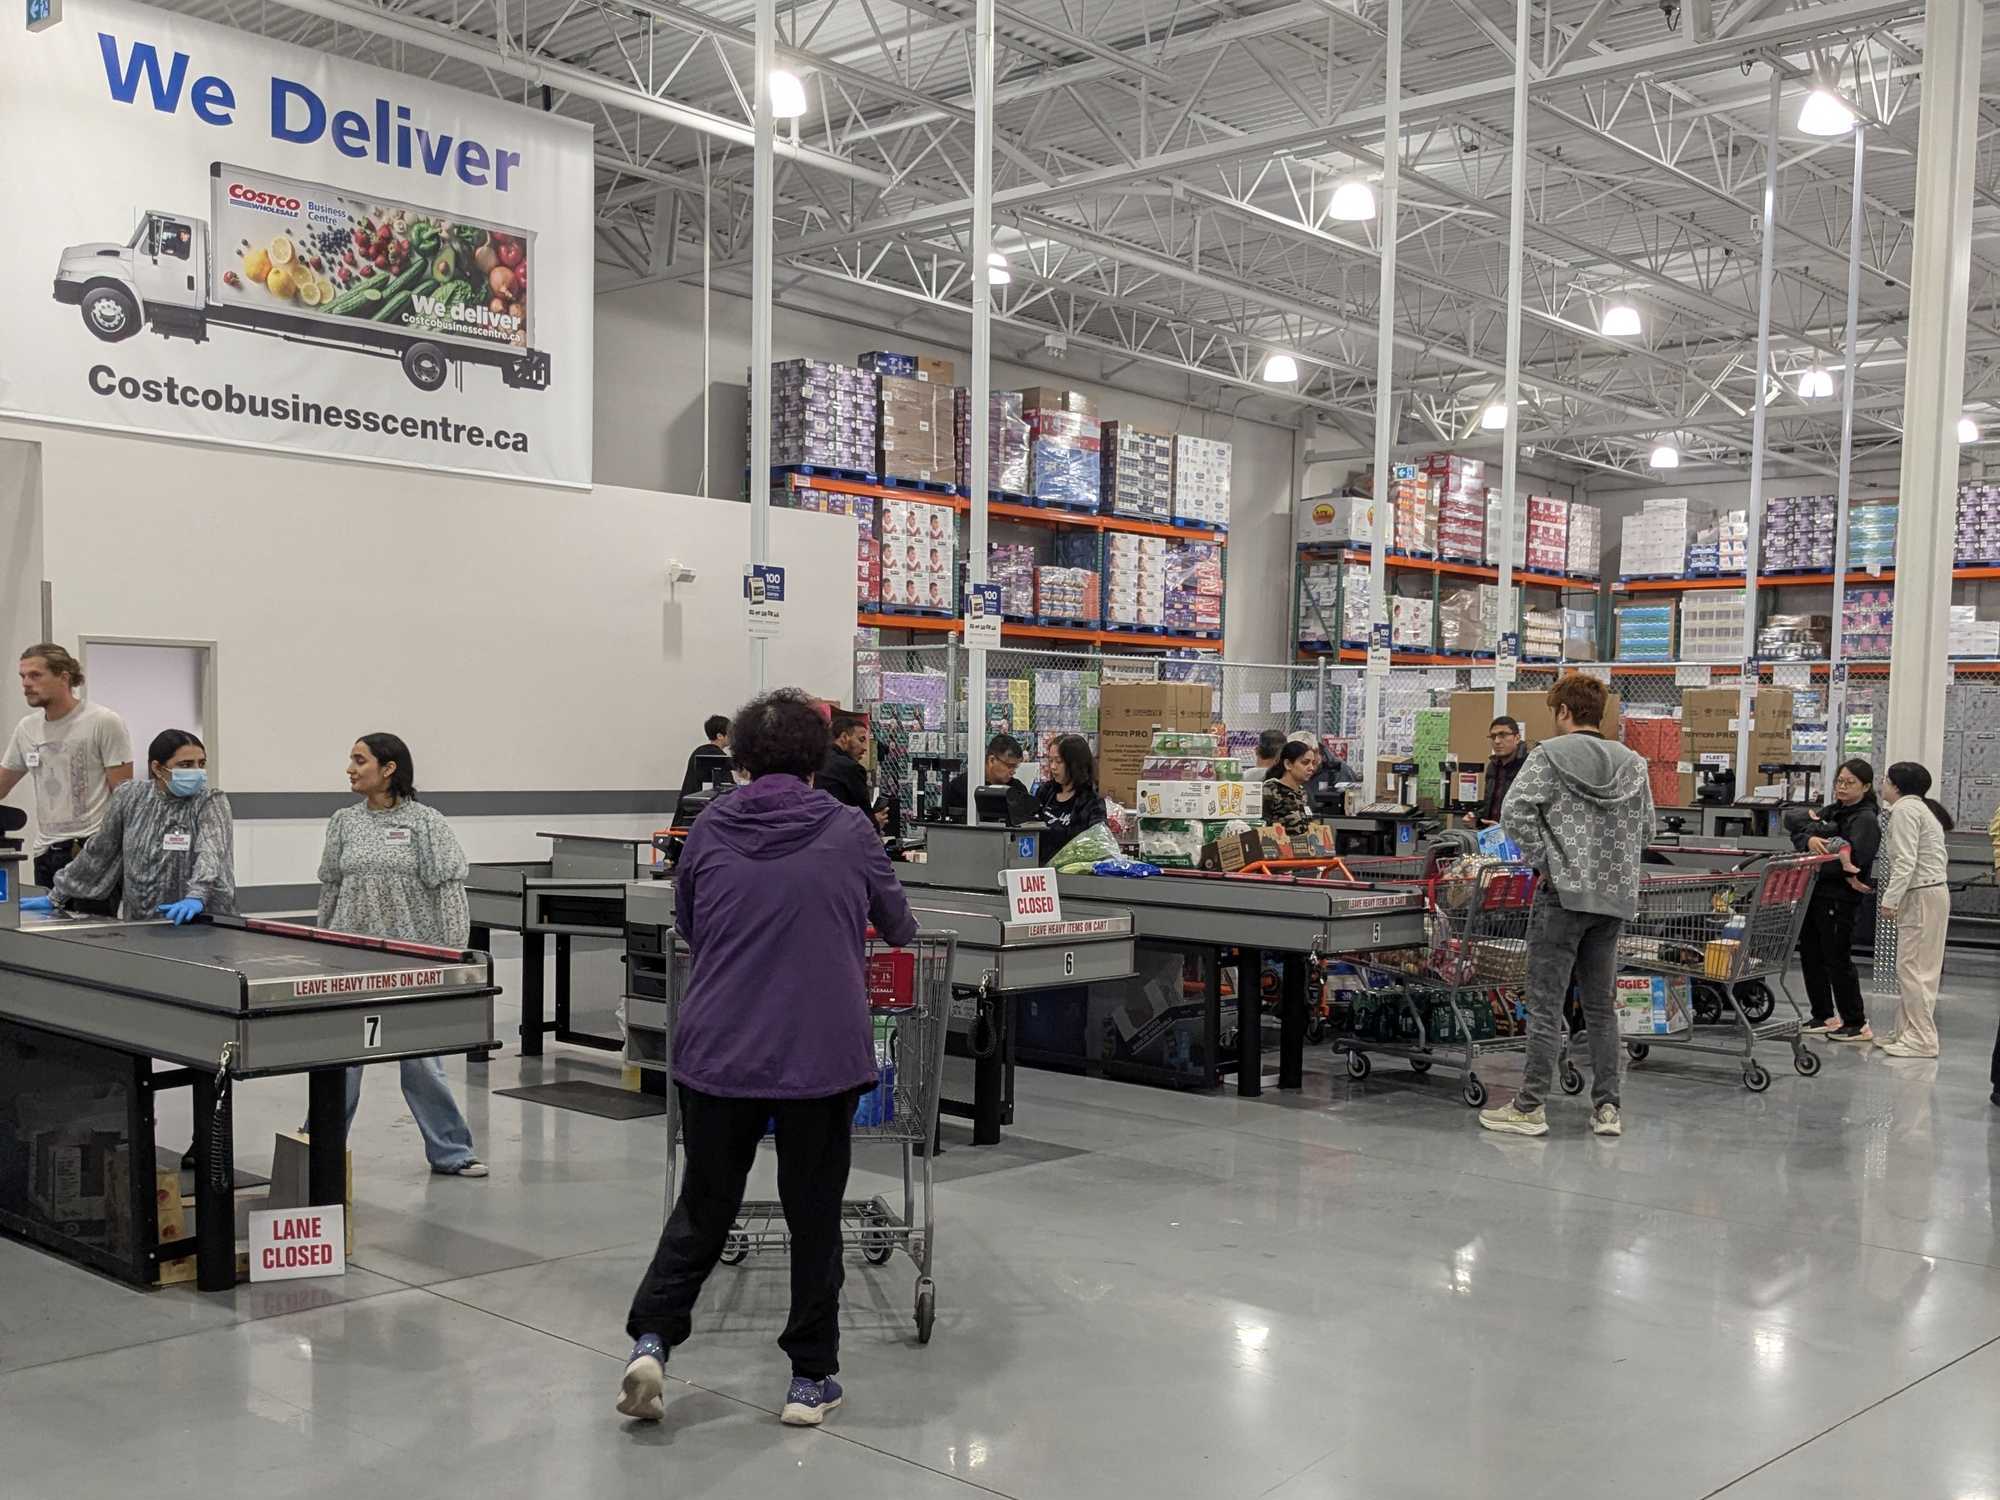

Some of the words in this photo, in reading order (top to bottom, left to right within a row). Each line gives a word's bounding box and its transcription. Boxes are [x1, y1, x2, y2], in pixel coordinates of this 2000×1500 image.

[98, 31, 236, 127] We
[270, 75, 521, 193] Deliver
[229, 184, 301, 211] COSTCO
[250, 202, 299, 218] WHOLESALE
[308, 201, 346, 218] Business
[308, 211, 338, 226] Centre
[411, 294, 446, 318] We
[450, 303, 521, 331] deliver
[401, 312, 521, 342] Costcobusinesscentre.ca
[88, 364, 529, 454] Costcobusinesscentre.ca
[765, 573, 781, 584] 100
[984, 590, 998, 600] 100
[1020, 875, 1046, 892] LANE
[1017, 896, 1054, 915] CLOSED
[1029, 925, 1048, 936] LEAVE
[1048, 923, 1066, 935] HEAVY
[1066, 922, 1084, 933] ITEMS
[1085, 921, 1092, 931] ON
[1093, 920, 1107, 931] CART
[1374, 923, 1380, 941] 5
[1066, 953, 1073, 974] 6
[296, 979, 328, 996] LEAVE
[331, 977, 364, 993] HEAVY
[367, 974, 397, 990] ITEMS
[401, 973, 413, 987] ON
[417, 971, 442, 986] CART
[366, 1016, 379, 1047] 7
[273, 1217, 322, 1241] LANE
[262, 1243, 333, 1270] CLOSED
